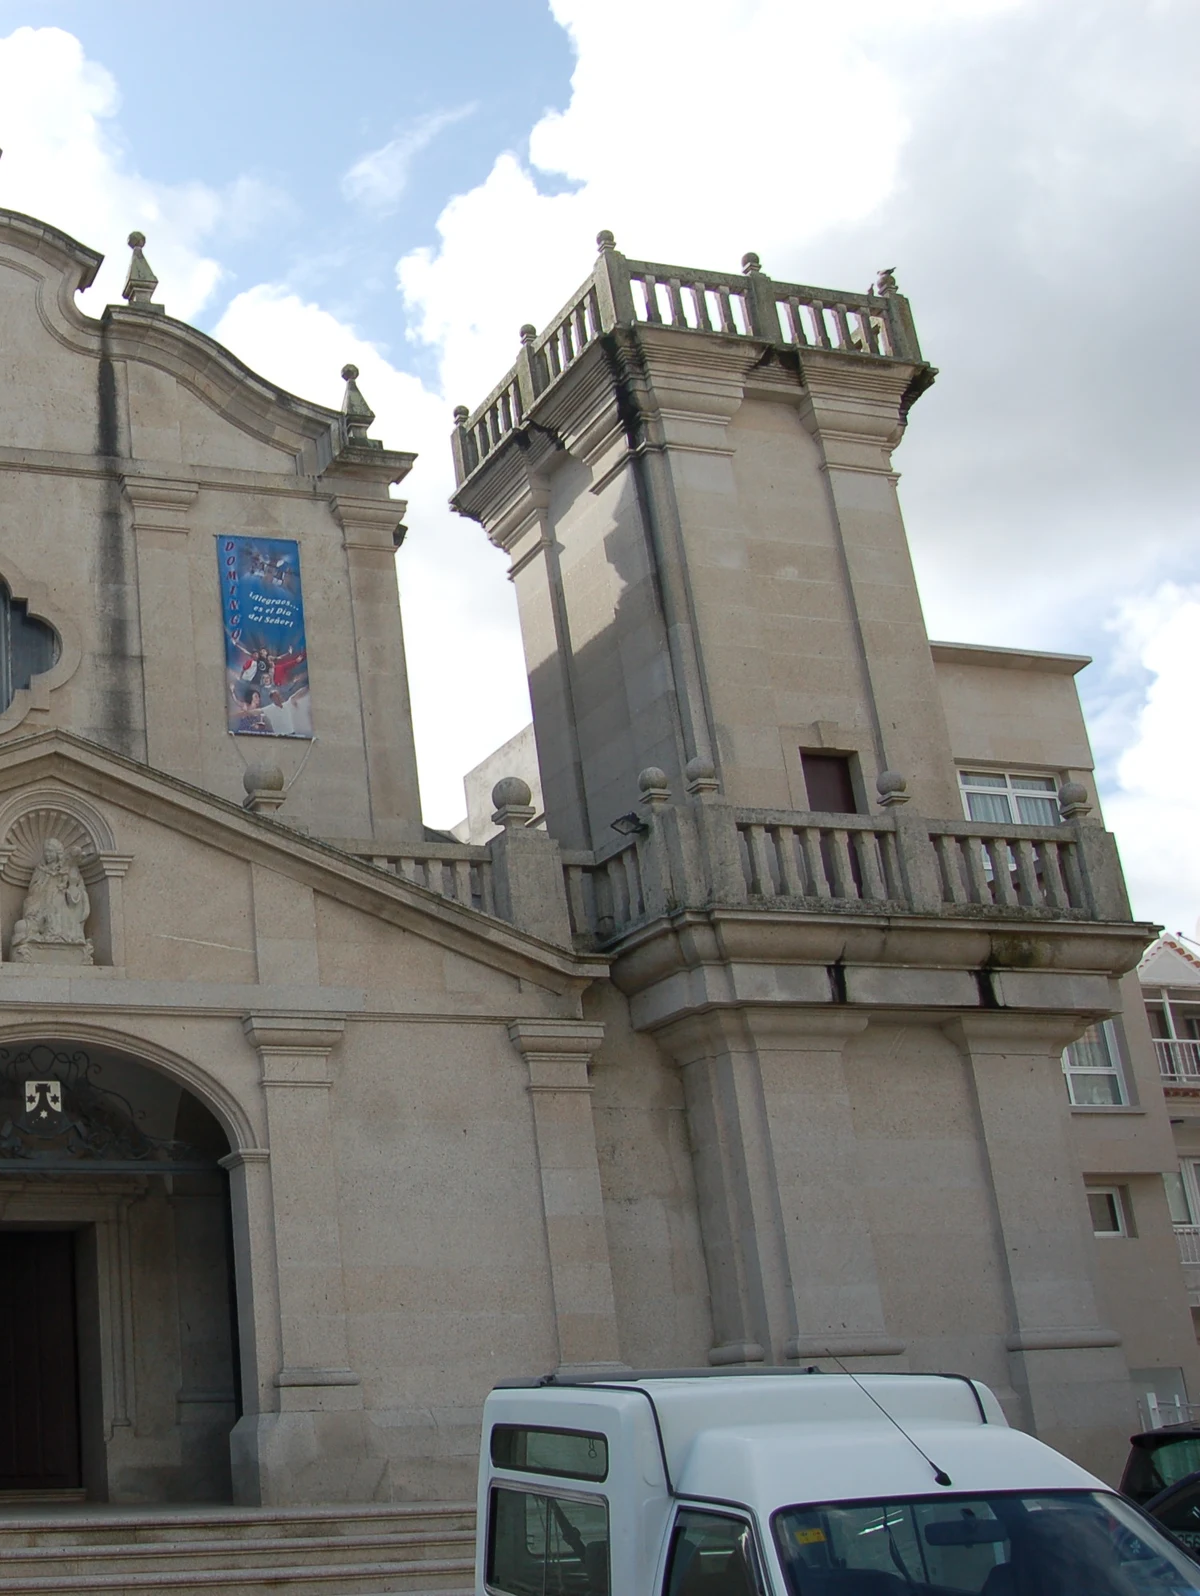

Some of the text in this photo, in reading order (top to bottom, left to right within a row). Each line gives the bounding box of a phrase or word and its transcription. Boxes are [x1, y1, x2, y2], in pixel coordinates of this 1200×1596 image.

[225, 541, 242, 641] DOMINGO
[248, 613, 293, 628] del Señor!
